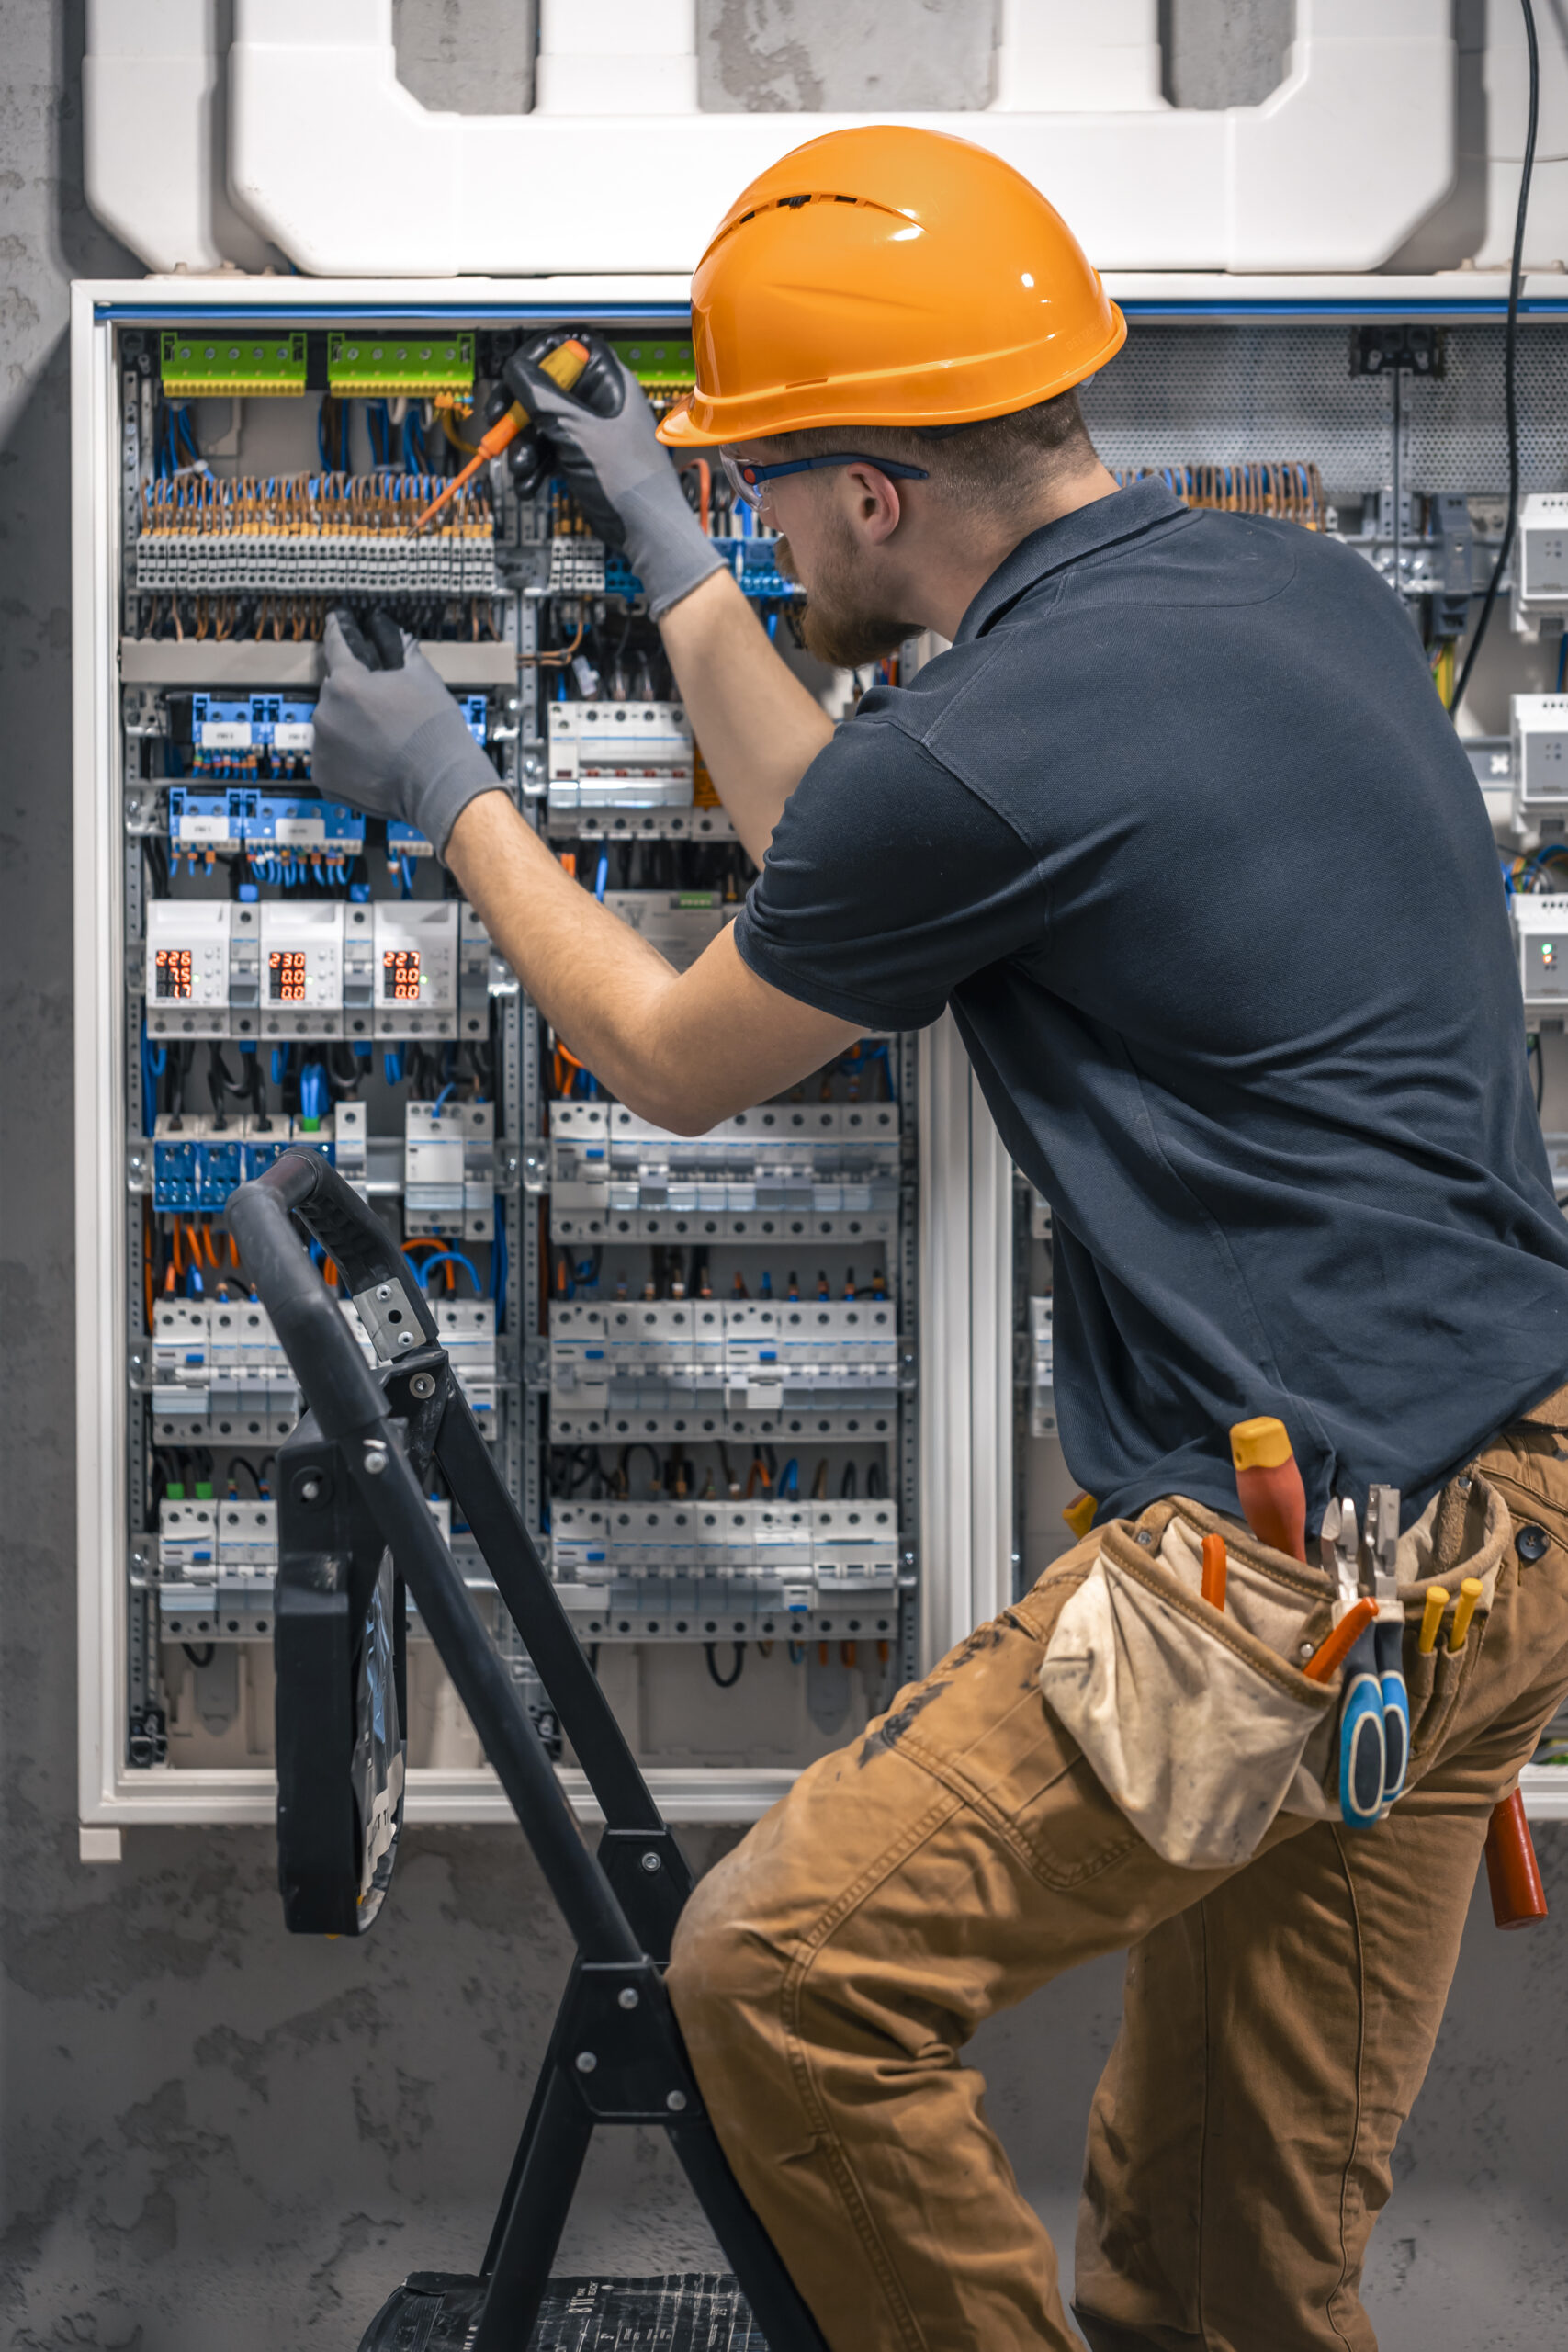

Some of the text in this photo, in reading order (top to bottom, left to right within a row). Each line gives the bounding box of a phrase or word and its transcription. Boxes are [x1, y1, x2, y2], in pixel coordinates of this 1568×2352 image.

[155, 950, 191, 967] 226
[268, 952, 306, 968] 230
[383, 951, 420, 967] 227
